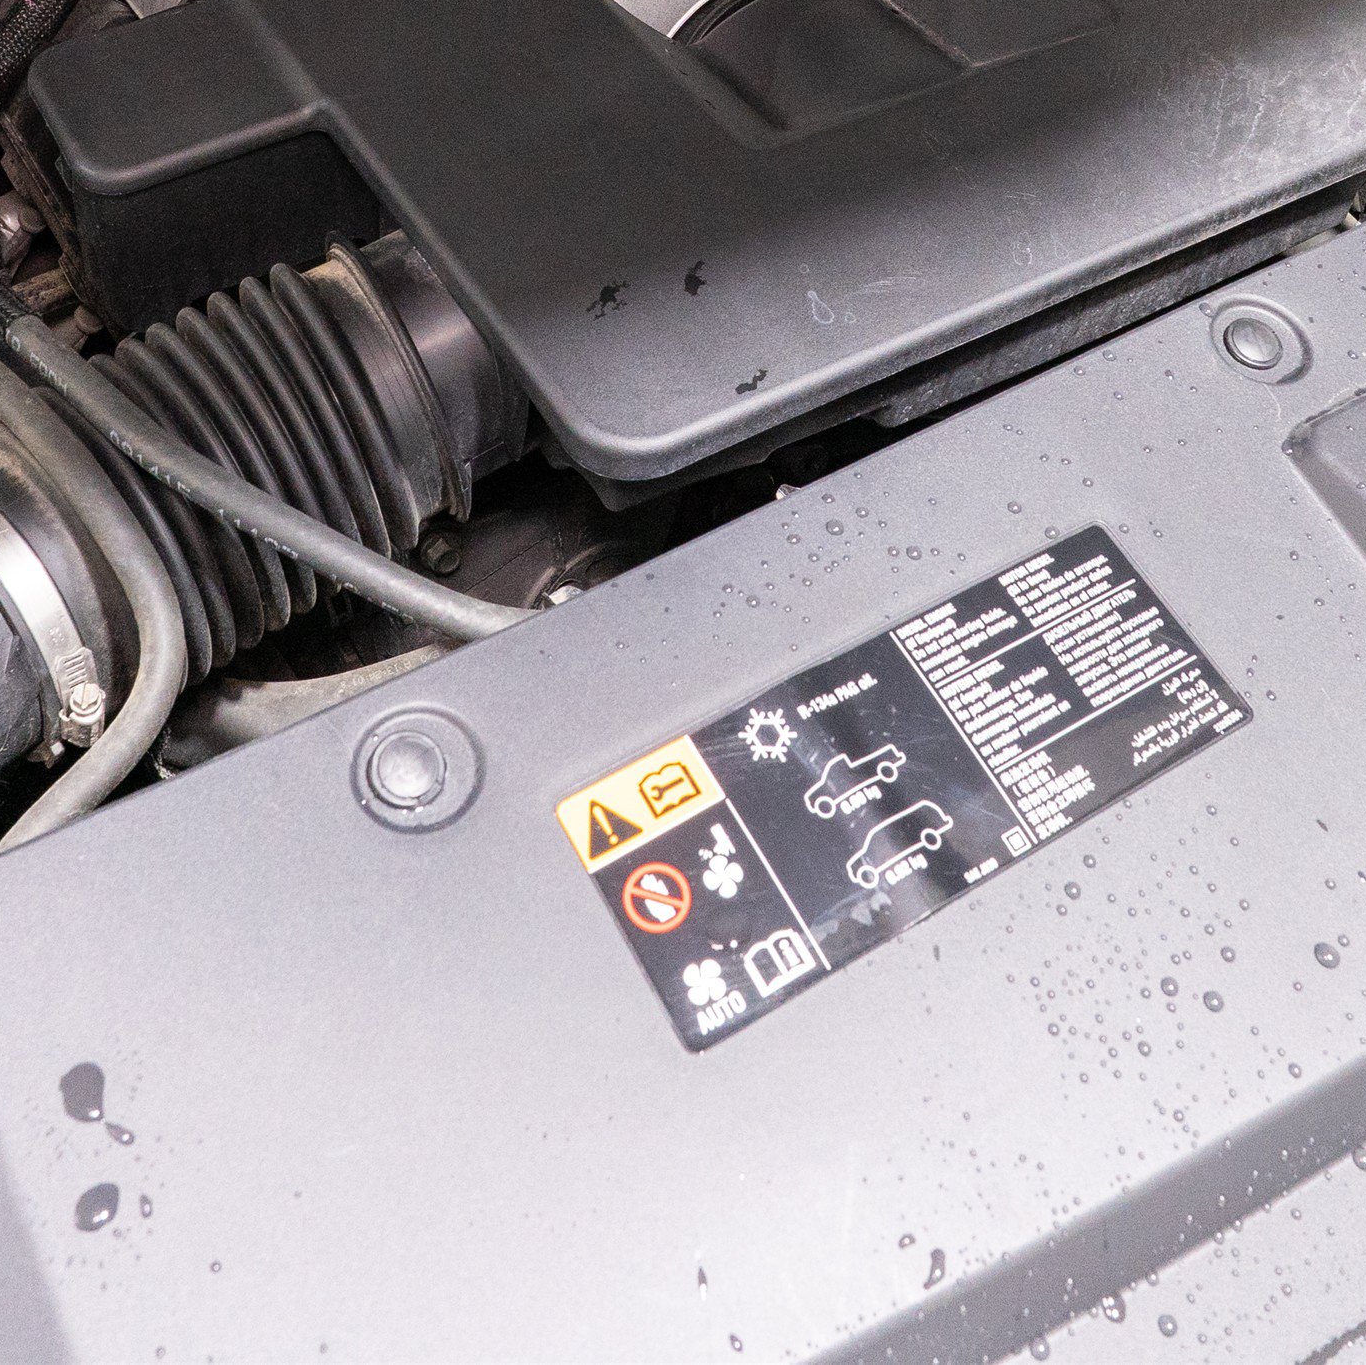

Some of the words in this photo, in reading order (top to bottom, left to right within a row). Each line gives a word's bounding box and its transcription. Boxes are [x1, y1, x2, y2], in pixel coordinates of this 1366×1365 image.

[796, 693, 838, 719] R-134a
[834, 681, 860, 701] PAG
[857, 673, 877, 690] oil.
[696, 989, 746, 1035] AUTO
